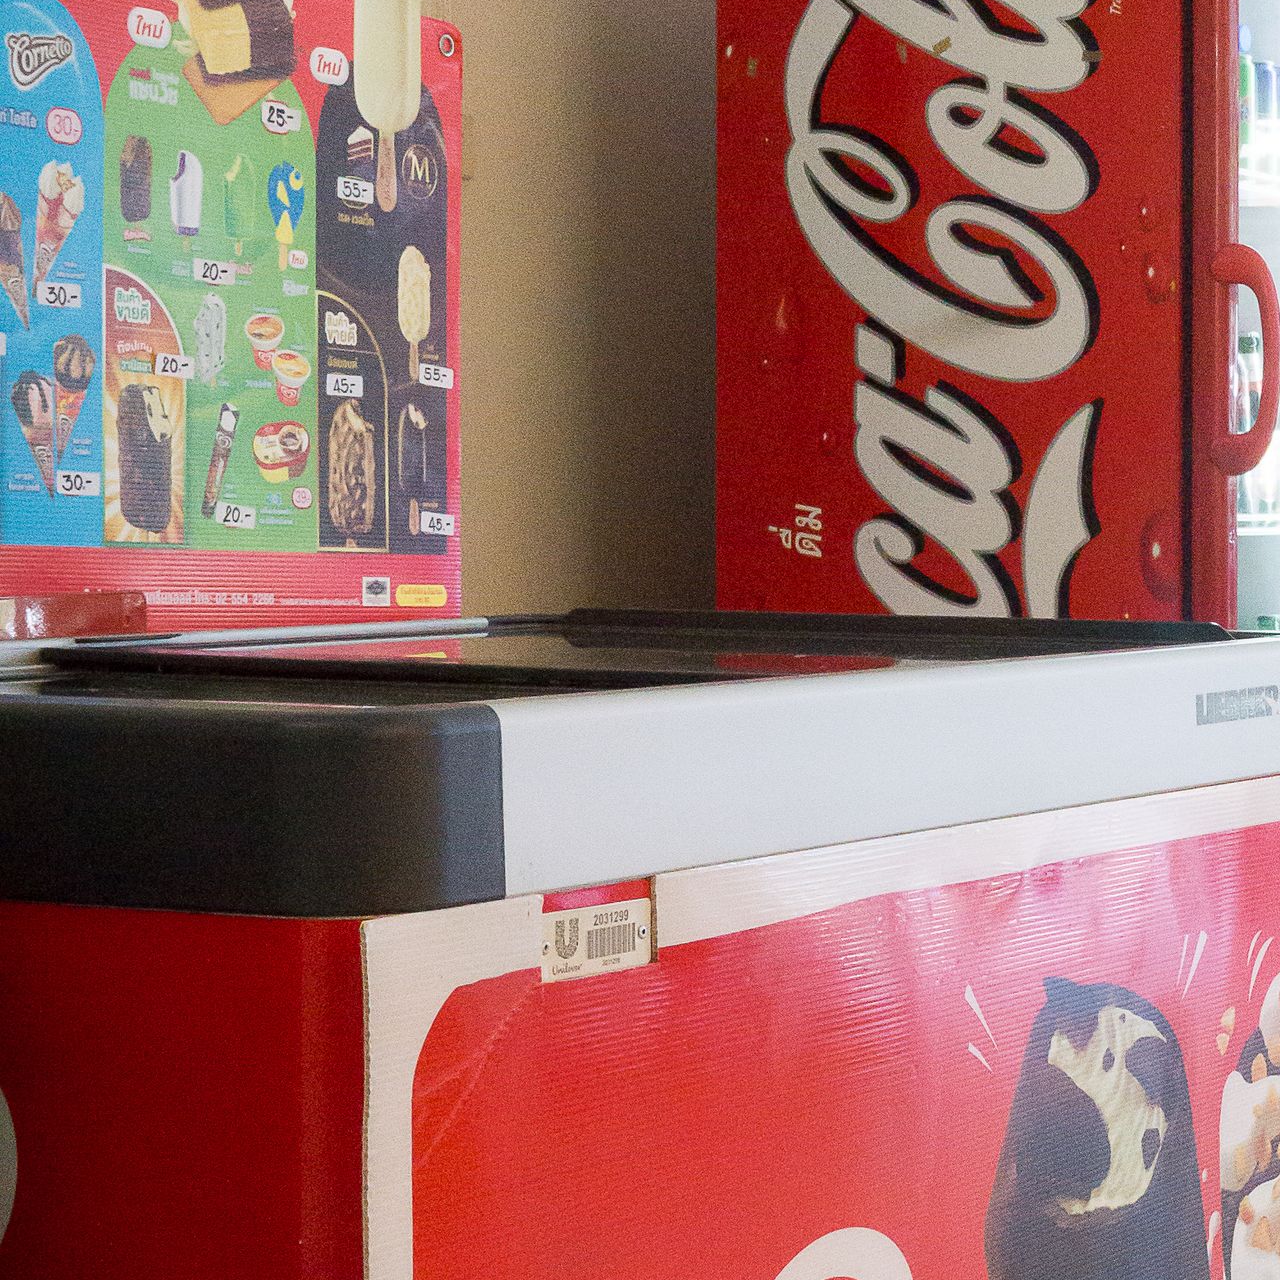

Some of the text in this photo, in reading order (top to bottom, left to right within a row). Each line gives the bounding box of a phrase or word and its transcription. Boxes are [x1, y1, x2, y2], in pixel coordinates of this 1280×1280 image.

[136, 14, 164, 39] ใหม่
[7, 33, 73, 87] Cornetto
[317, 54, 342, 77] ใหม่
[202, 262, 228, 281] 20.-
[46, 286, 78, 306] 30.-
[161, 356, 189, 373] 20.-
[423, 367, 448, 383] 55.-
[333, 377, 356, 394] 45.-
[62, 473, 92, 492] 30.-
[223, 505, 251, 523] 20.-
[428, 516, 451, 531] 45.-
[593, 909, 629, 926] 2031299
